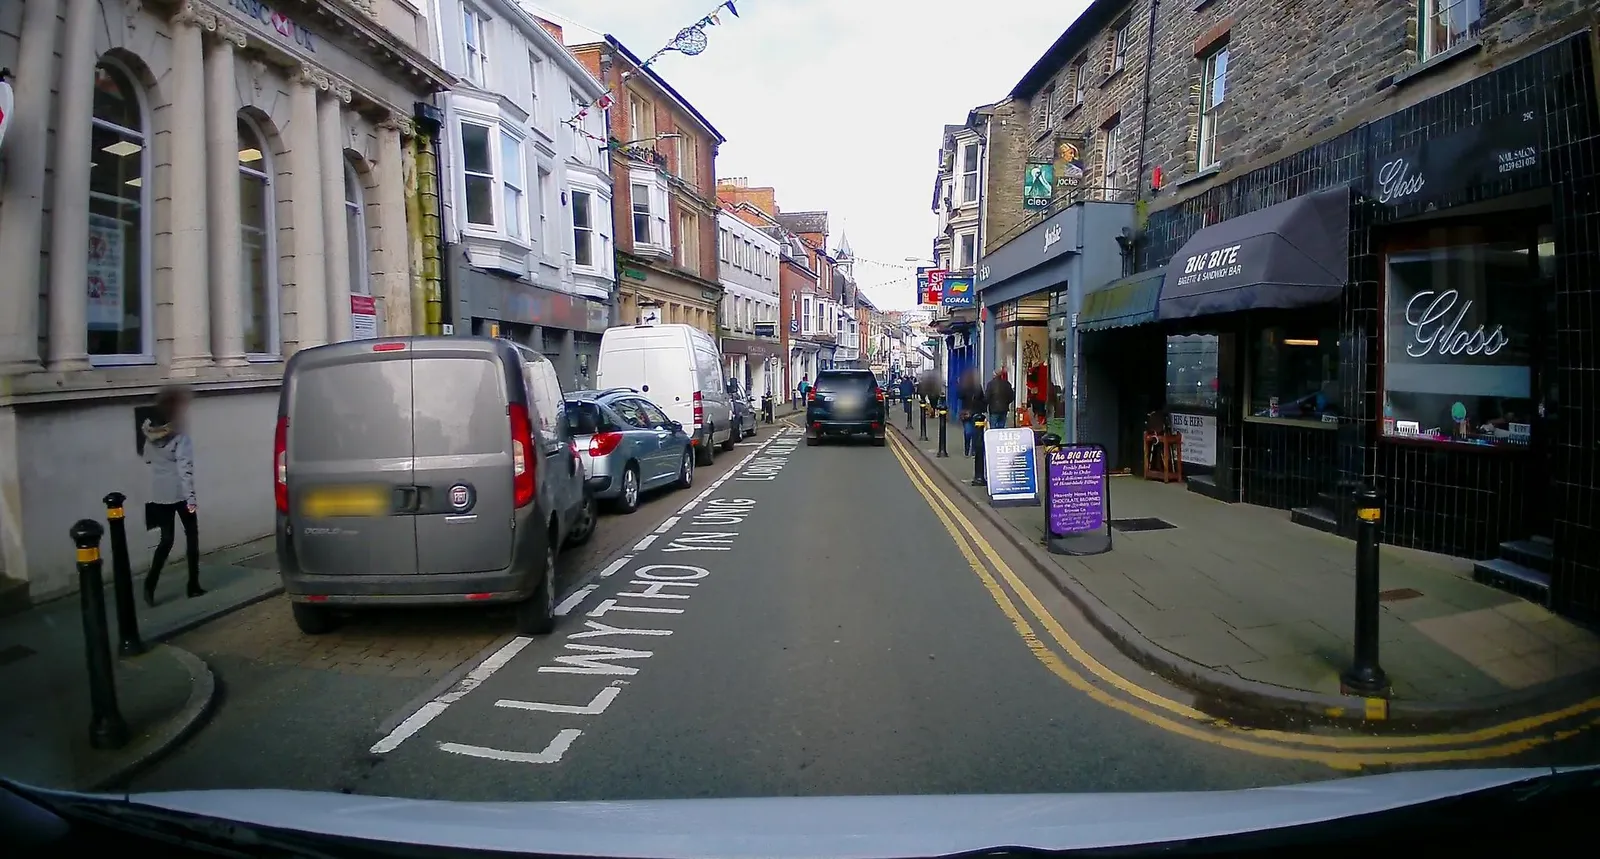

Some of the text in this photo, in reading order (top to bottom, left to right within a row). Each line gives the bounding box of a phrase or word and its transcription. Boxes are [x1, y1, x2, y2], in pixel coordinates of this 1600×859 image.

[229, 0, 316, 53] SBC UK
[1499, 147, 1536, 163] NAIL SALON
[1379, 158, 1425, 203] Gloss
[1027, 197, 1047, 206] cleo
[1184, 244, 1242, 274] BIG BITE
[1202, 268, 1228, 281] SANDWICH
[1228, 264, 1242, 276] BAR
[1405, 289, 1509, 357] Gloss
[1173, 414, 1204, 428] HIS & HERS
[998, 430, 1020, 441] HIS
[995, 444, 1028, 454] HERS
[1051, 450, 1103, 460] The BIG BITE
[438, 564, 710, 765] LLWYTHO
[661, 531, 740, 552] YN
